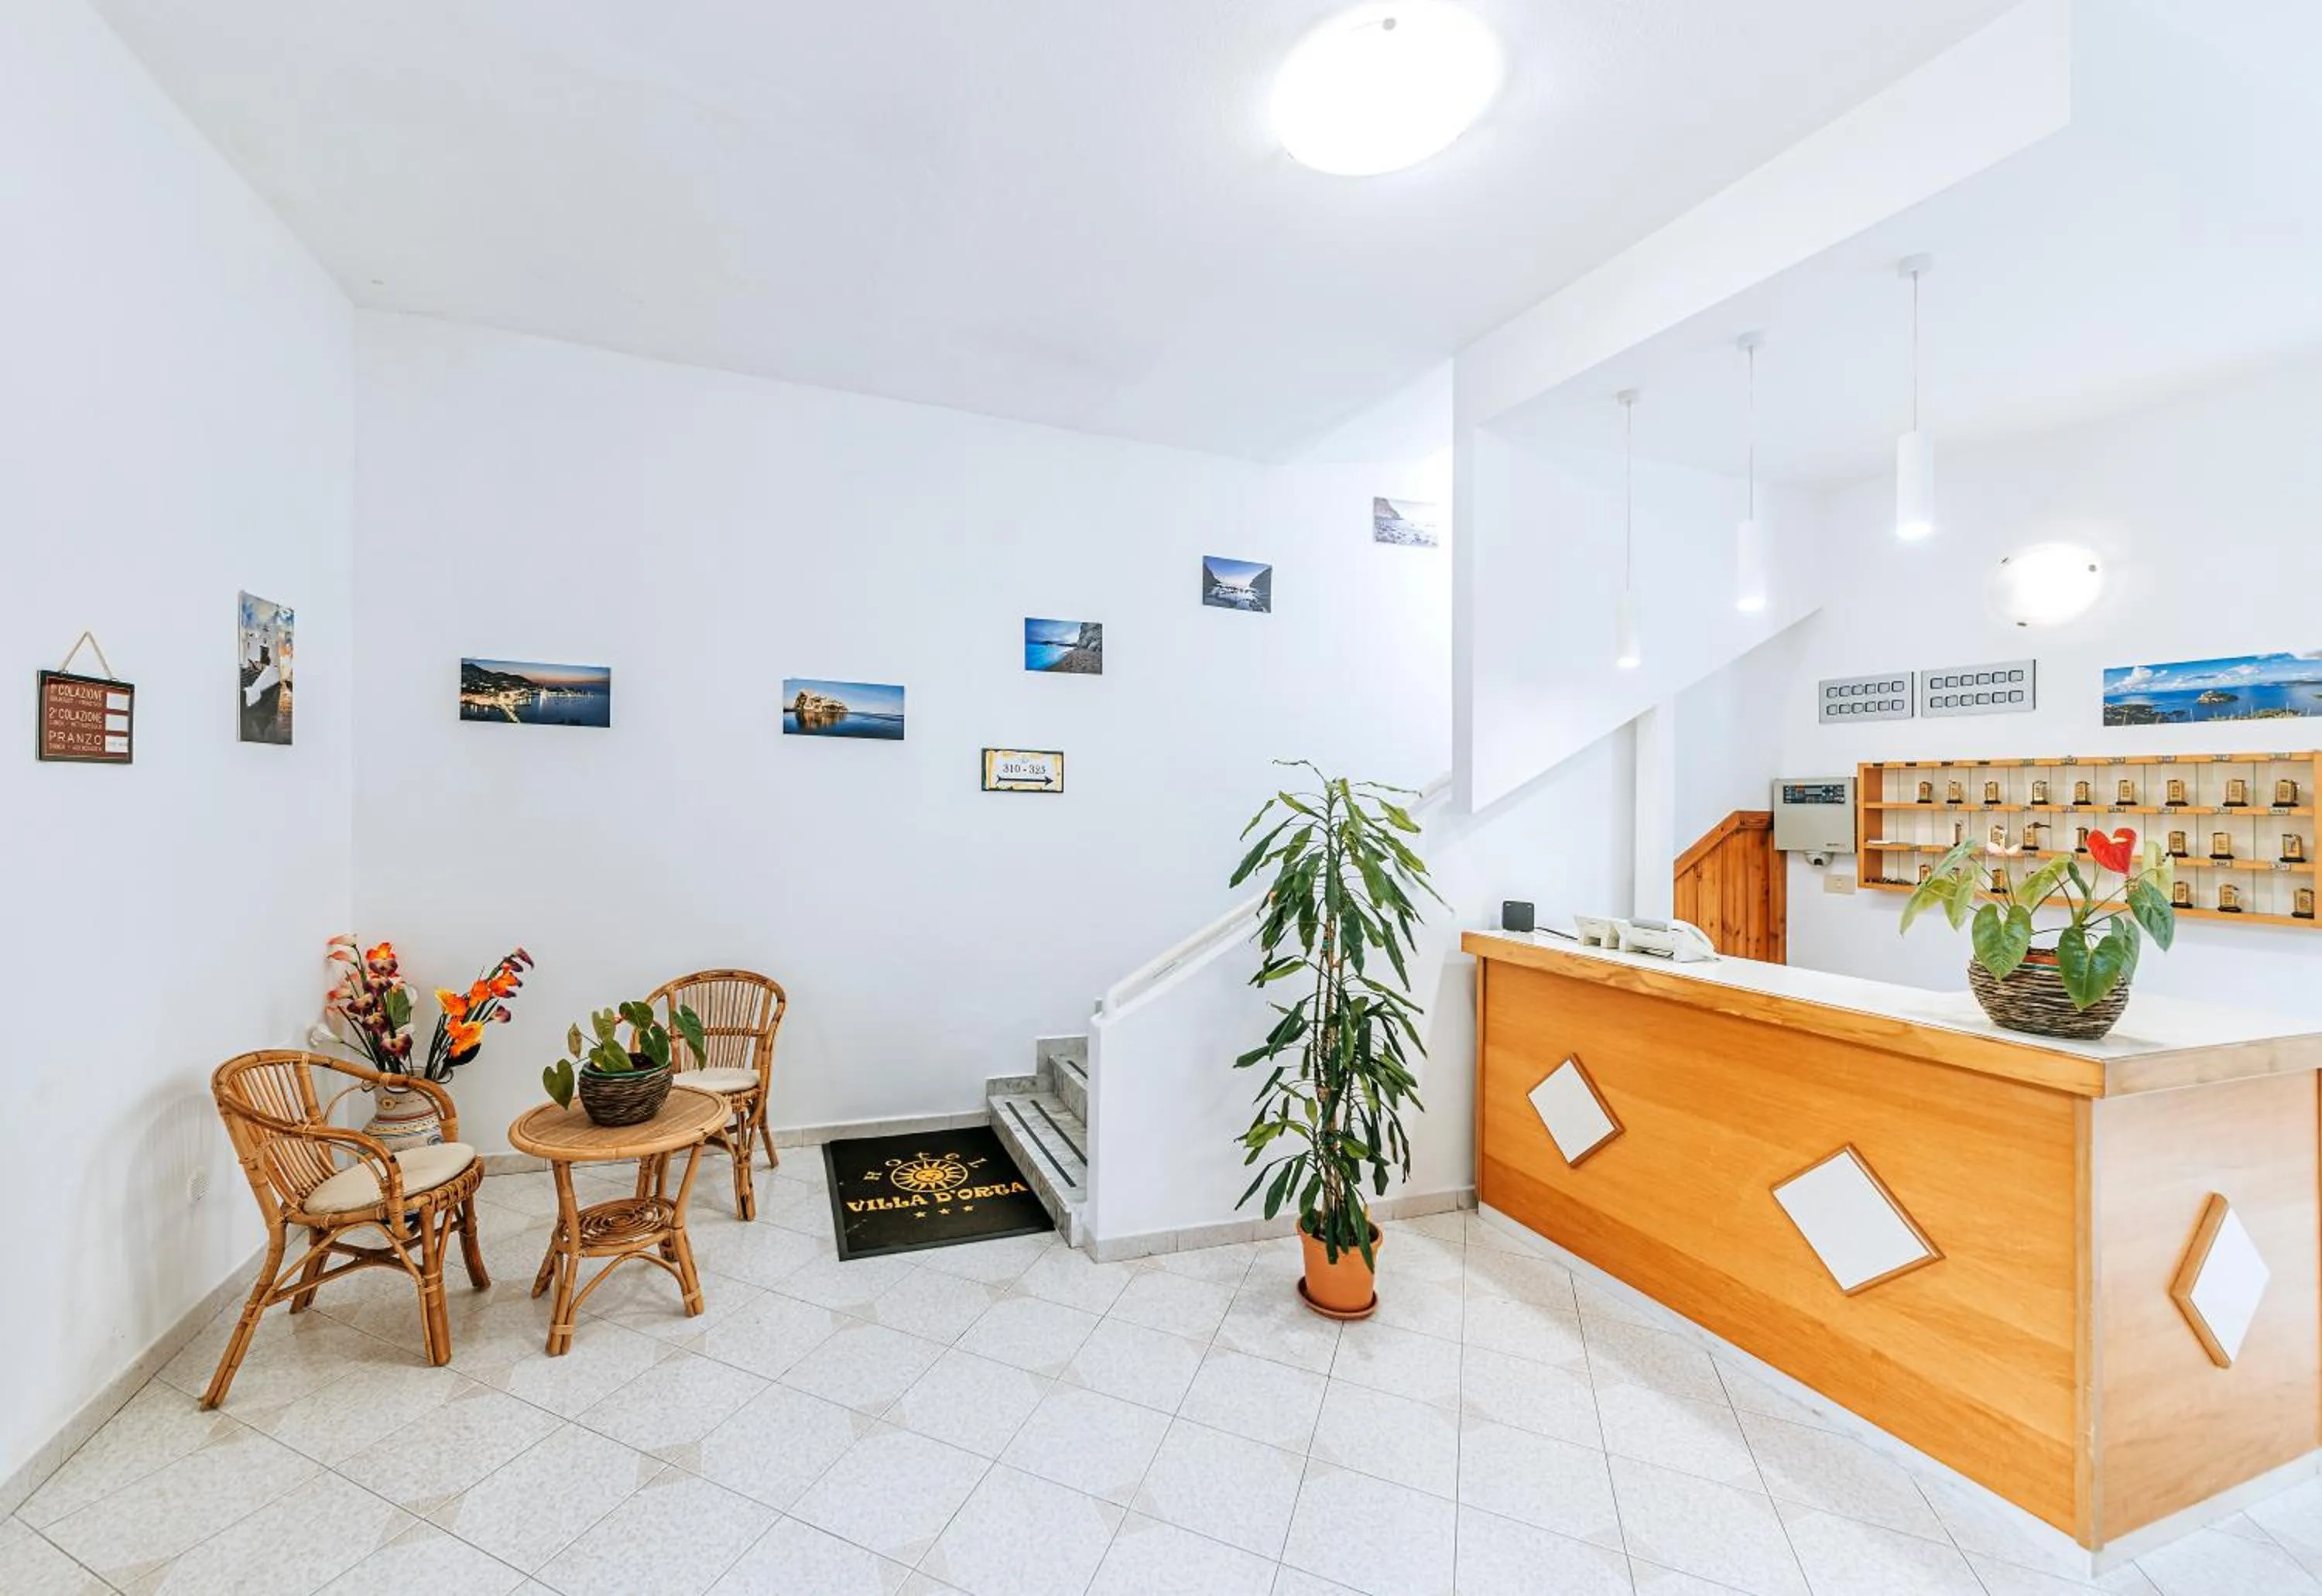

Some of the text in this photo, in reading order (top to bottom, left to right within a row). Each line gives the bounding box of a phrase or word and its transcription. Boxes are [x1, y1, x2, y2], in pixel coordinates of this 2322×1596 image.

[58, 684, 102, 699] COLAZIONE
[59, 708, 102, 723] COLAZIONE
[49, 731, 101, 745] PRANZO
[1003, 764, 1020, 773] 310
[863, 1152, 988, 1181] HOTEL
[847, 1182, 1029, 1212] VILLA D'ORTA
